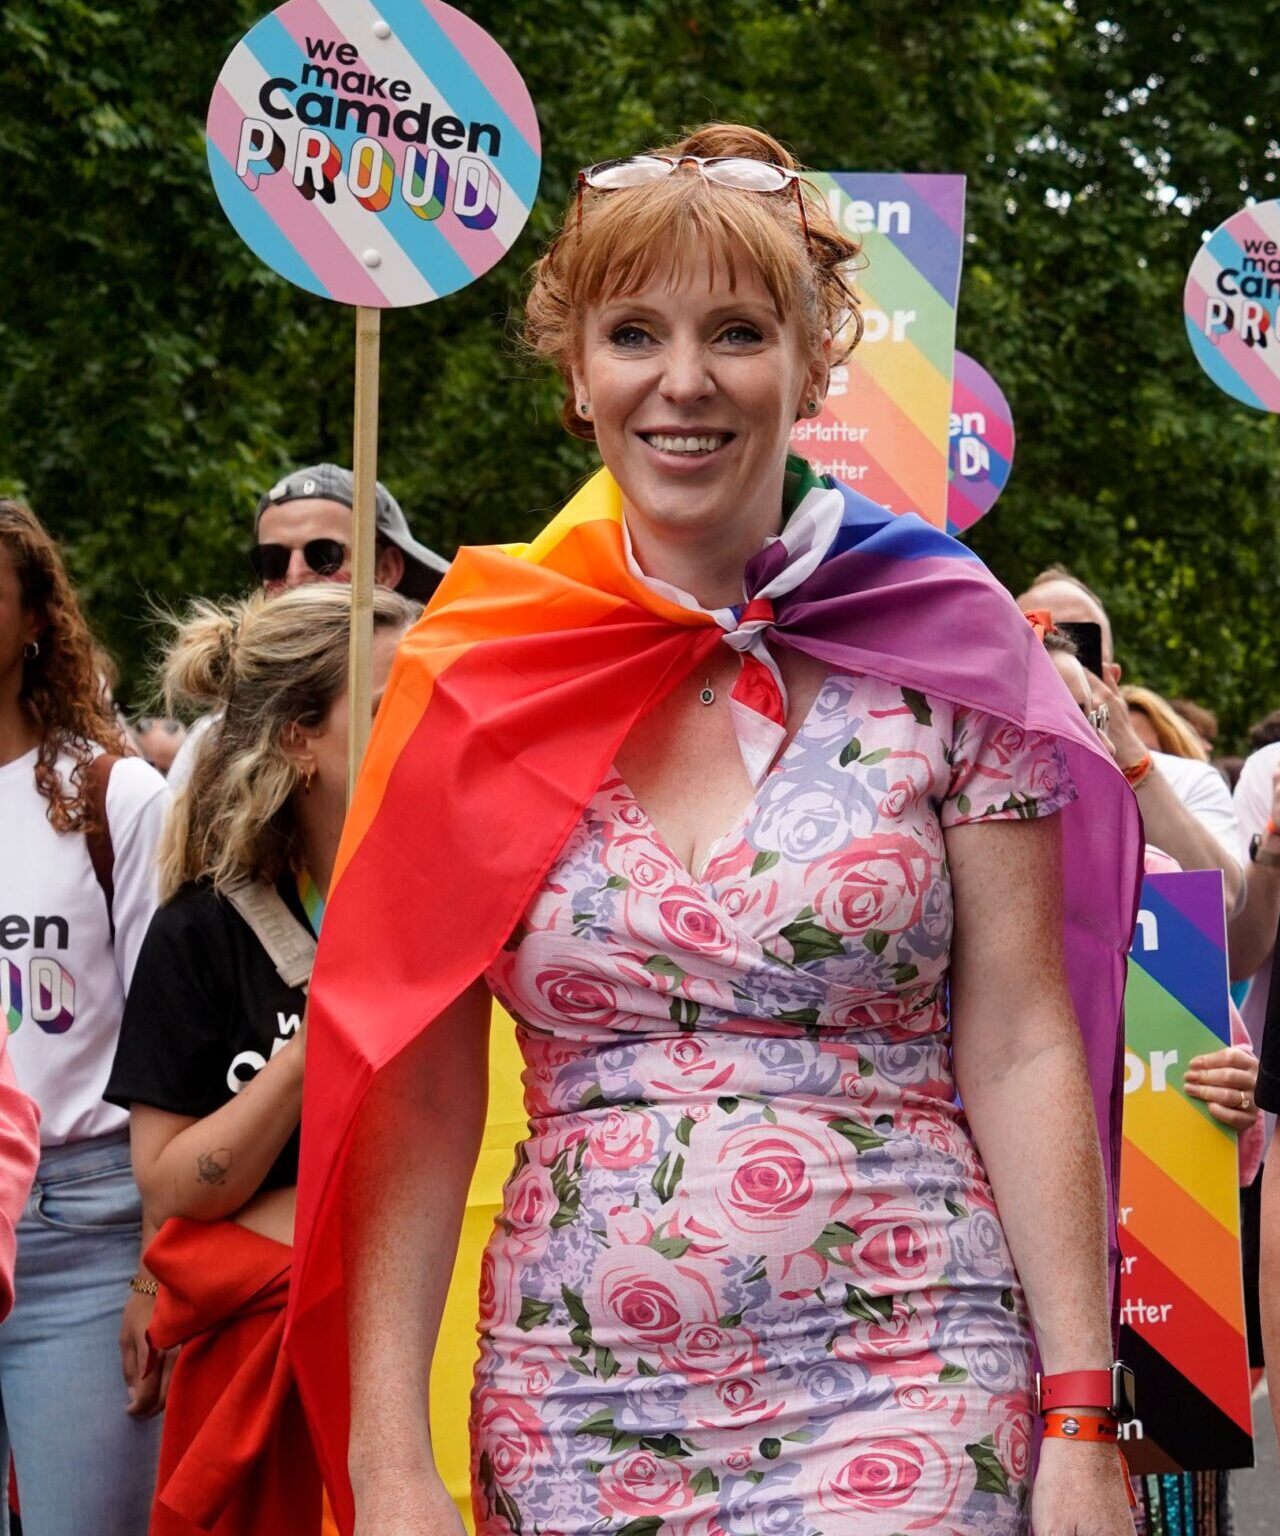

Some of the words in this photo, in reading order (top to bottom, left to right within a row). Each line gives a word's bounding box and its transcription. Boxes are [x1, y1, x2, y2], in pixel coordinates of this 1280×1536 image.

[305, 37, 359, 65] we
[301, 63, 412, 102] make
[259, 77, 501, 157] Camden
[236, 117, 502, 231] PROUD
[1243, 239, 1278, 256] we
